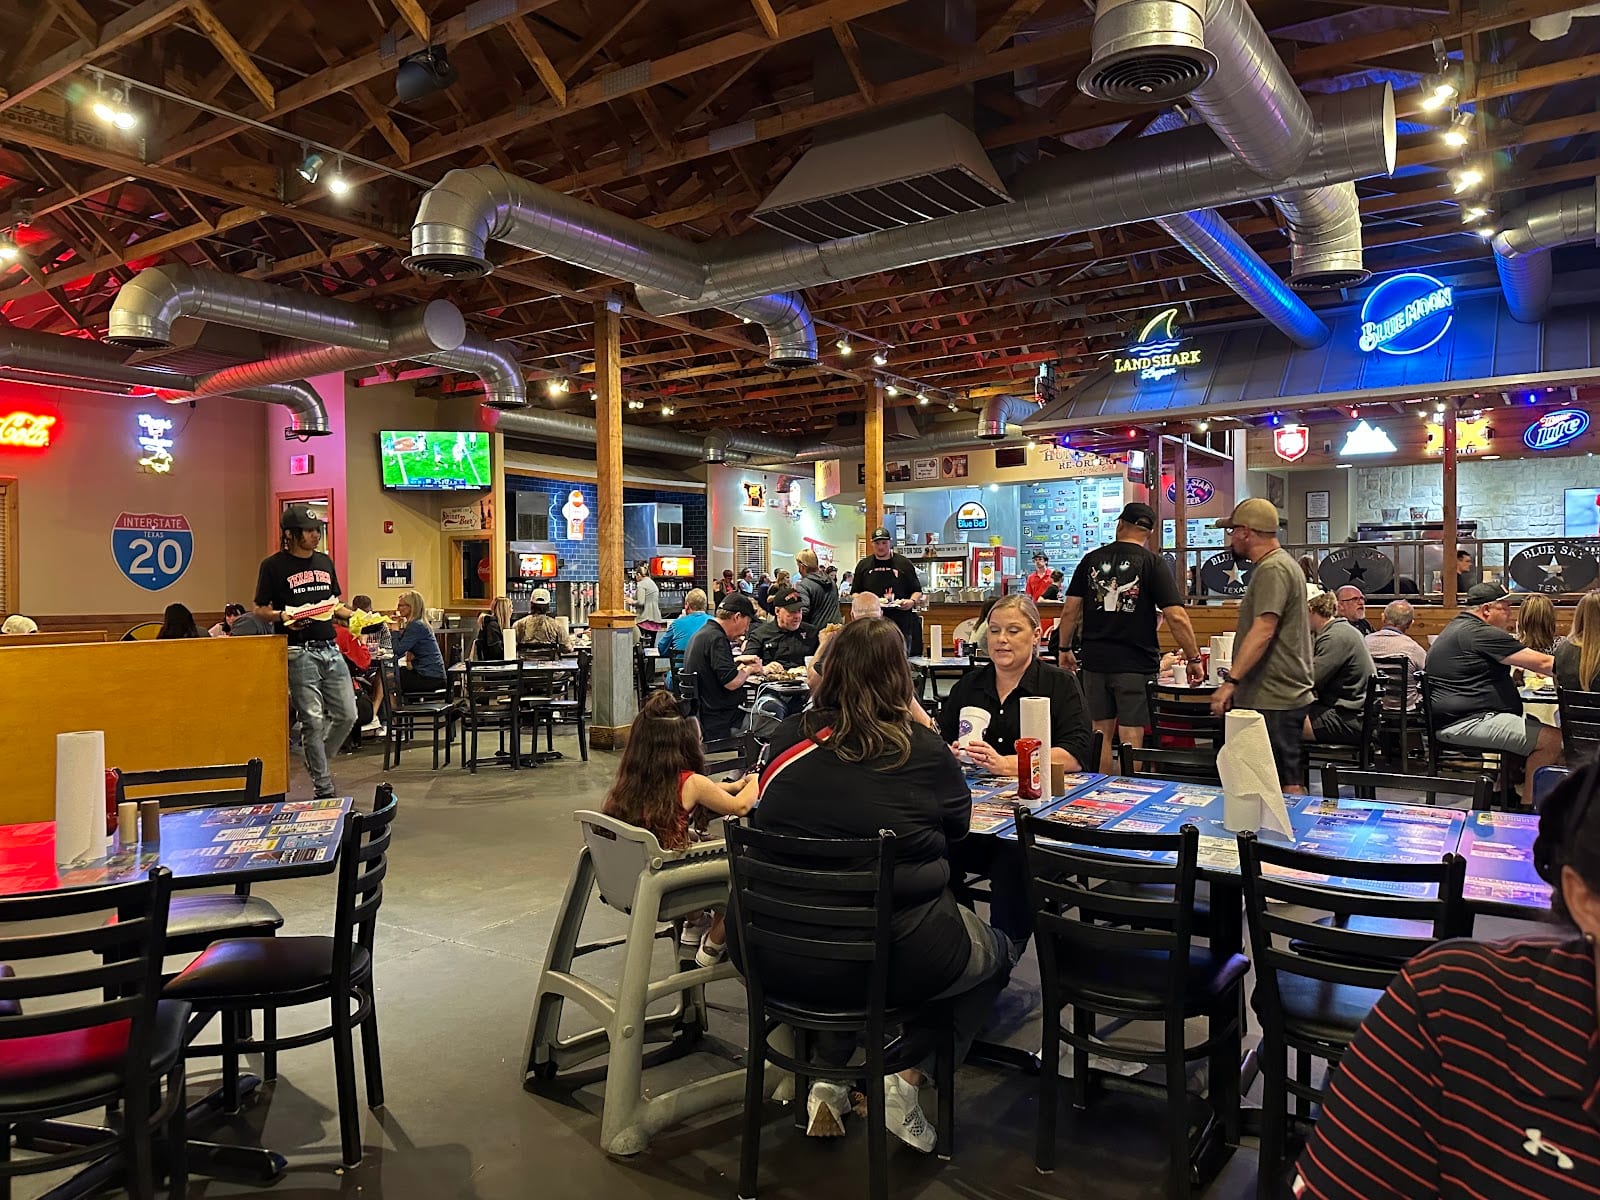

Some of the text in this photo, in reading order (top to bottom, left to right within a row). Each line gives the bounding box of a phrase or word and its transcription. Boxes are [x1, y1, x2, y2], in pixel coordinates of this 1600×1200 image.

[1359, 286, 1453, 352] BLUE MOON
[1114, 350, 1201, 372] LANDSHARK
[1191, 479, 1211, 492] STAR
[123, 517, 182, 529] INTERSTATE
[958, 520, 986, 528] Blue Bell
[128, 538, 183, 575] 20
[1522, 545, 1556, 560] BLUE
[287, 570, 314, 589] TEXAS
[293, 587, 306, 595] RED
[1223, 585, 1248, 594] TEXAS
